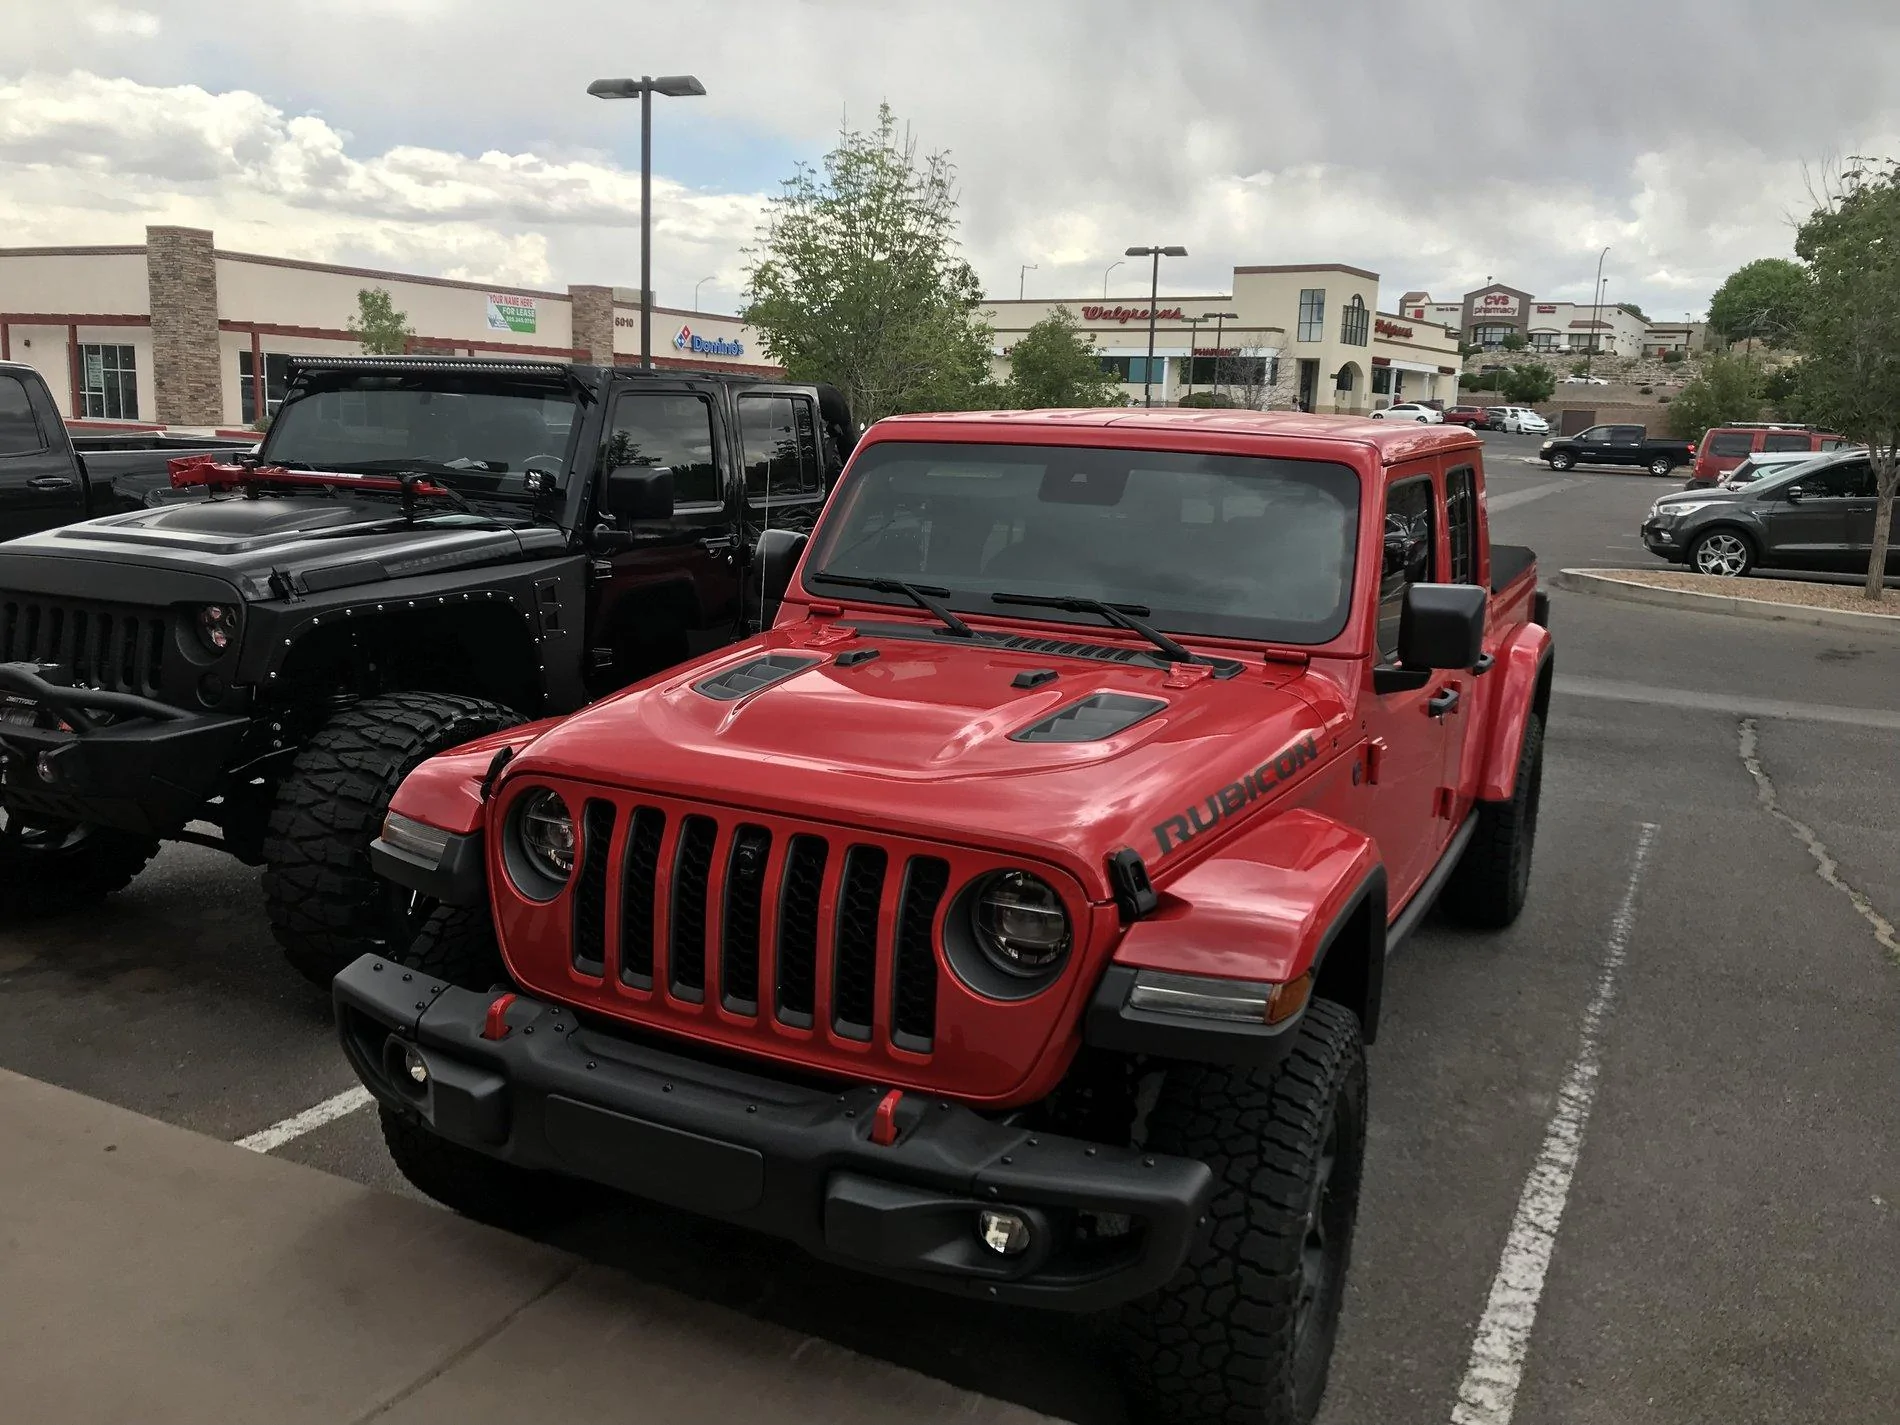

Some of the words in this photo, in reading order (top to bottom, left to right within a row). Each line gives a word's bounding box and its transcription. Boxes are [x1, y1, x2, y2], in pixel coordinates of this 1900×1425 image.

[1484, 294, 1509, 306] CVS
[502, 306, 515, 315] FOR
[516, 308, 535, 318] LEASE
[1082, 306, 1185, 324] Walgreens
[1474, 305, 1518, 315] pharmacy
[691, 334, 744, 356] Domino's
[1153, 736, 1318, 856] RUBICON
